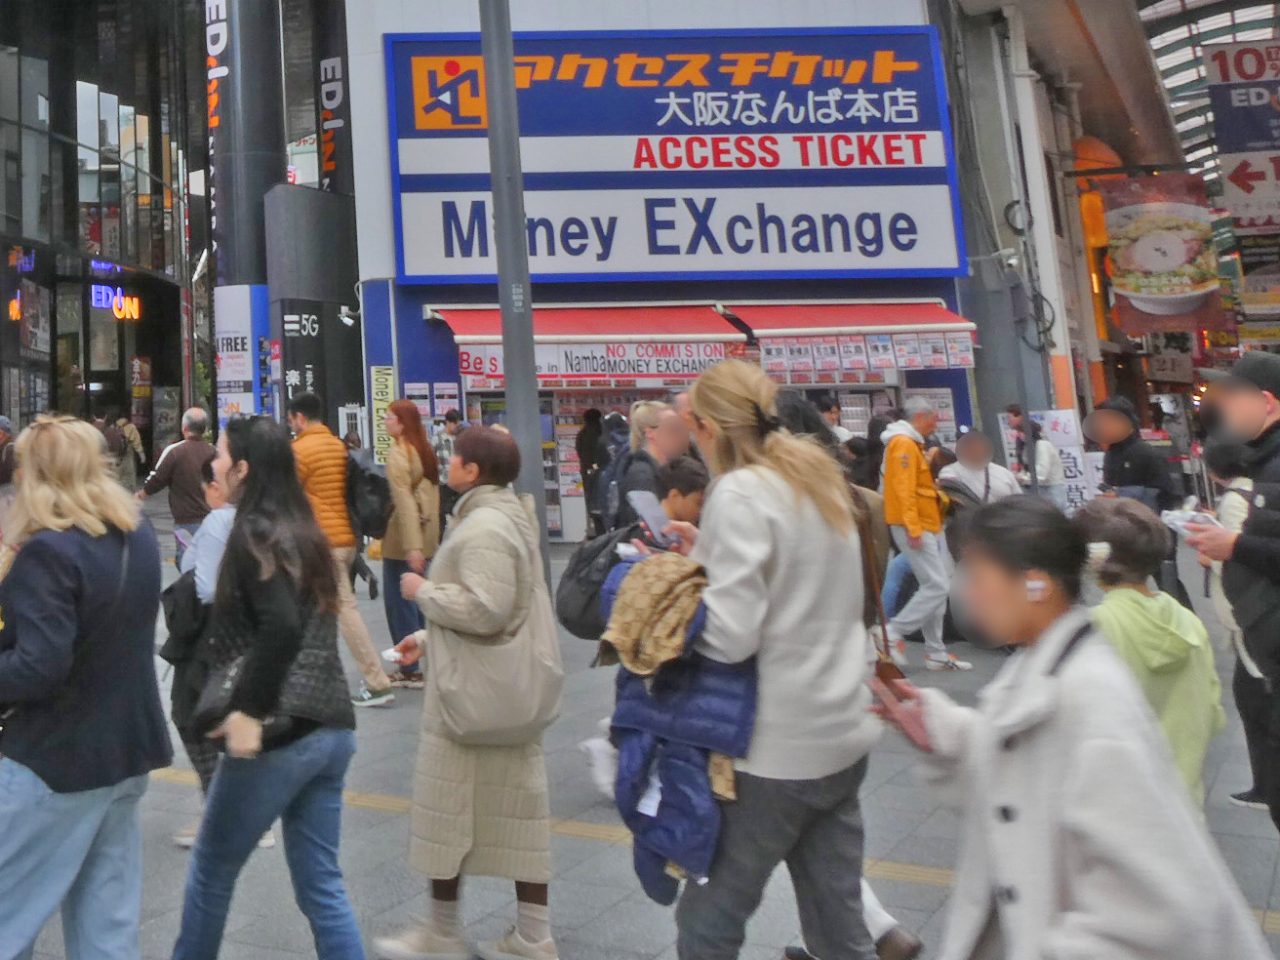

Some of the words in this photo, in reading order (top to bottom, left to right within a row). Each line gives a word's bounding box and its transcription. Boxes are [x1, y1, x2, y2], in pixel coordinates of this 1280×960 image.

[515, 50, 918, 88] アクセスチケット
[320, 57, 344, 172] EDION
[655, 88, 918, 127] 大阪なんば本店
[634, 137, 780, 169] ACCESS
[793, 133, 926, 166] TICKET
[441, 198, 617, 261] Mney
[644, 195, 918, 259] EXchange
[91, 284, 140, 320] EDION
[301, 313, 319, 337] 5G
[565, 351, 606, 372] Namba
[607, 343, 626, 358] NO
[607, 360, 650, 374] MONEY
[374, 368, 392, 401] Money
